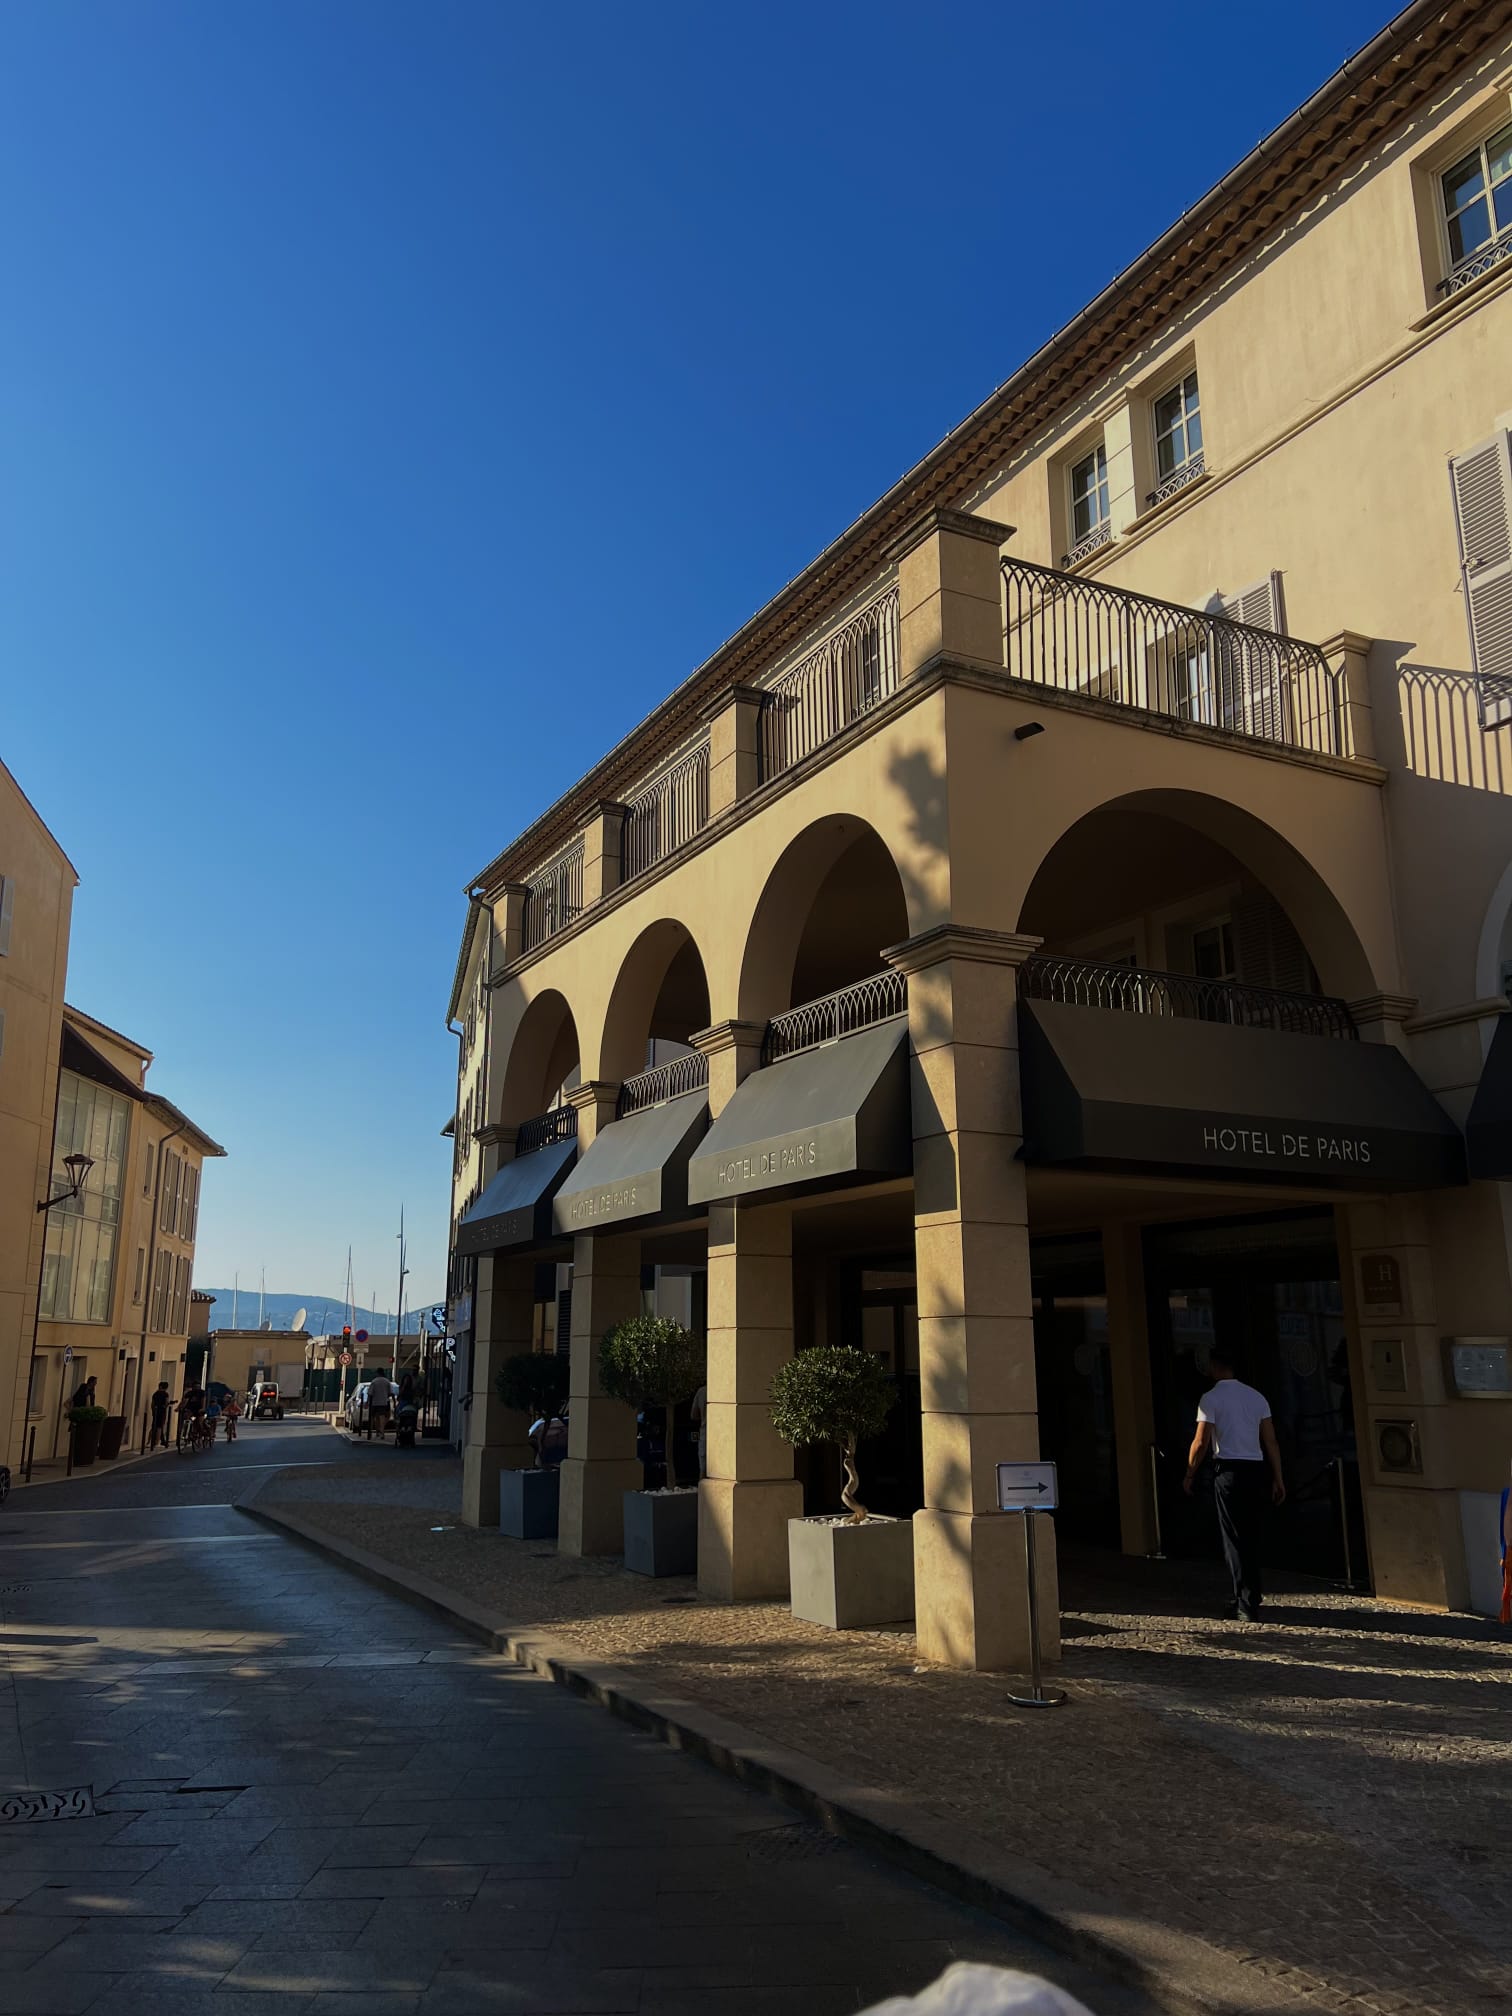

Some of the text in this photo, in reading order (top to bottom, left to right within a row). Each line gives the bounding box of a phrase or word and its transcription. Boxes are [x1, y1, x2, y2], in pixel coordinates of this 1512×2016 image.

[1203, 1127, 1371, 1163] HOTEL DE PARIS
[718, 1142, 816, 1184] HOTEL DE PARIS
[571, 1186, 637, 1219] HOTEL DE PARIS
[1379, 1264, 1392, 1280] H
